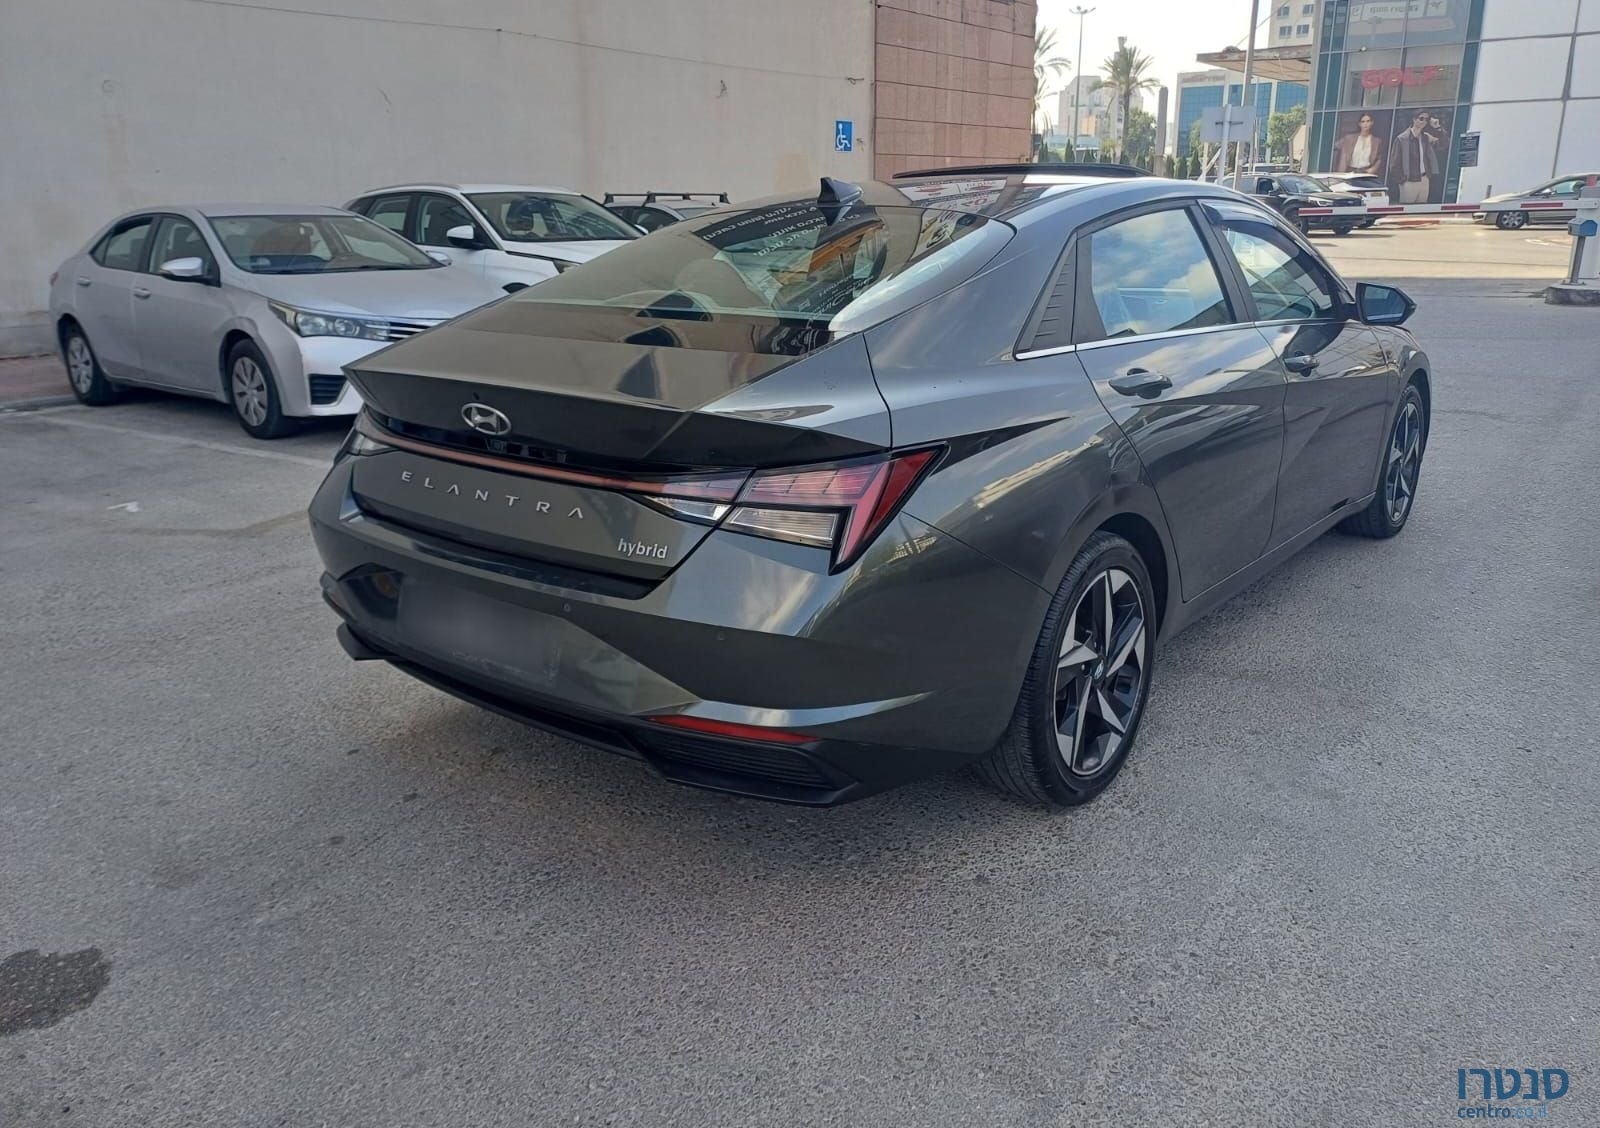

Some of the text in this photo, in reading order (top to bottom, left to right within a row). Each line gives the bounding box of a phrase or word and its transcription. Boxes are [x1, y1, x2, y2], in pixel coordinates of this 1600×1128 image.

[1362, 65, 1437, 88] GOLF
[401, 471, 584, 519] ELANTRA
[617, 537, 669, 561] hybrid
